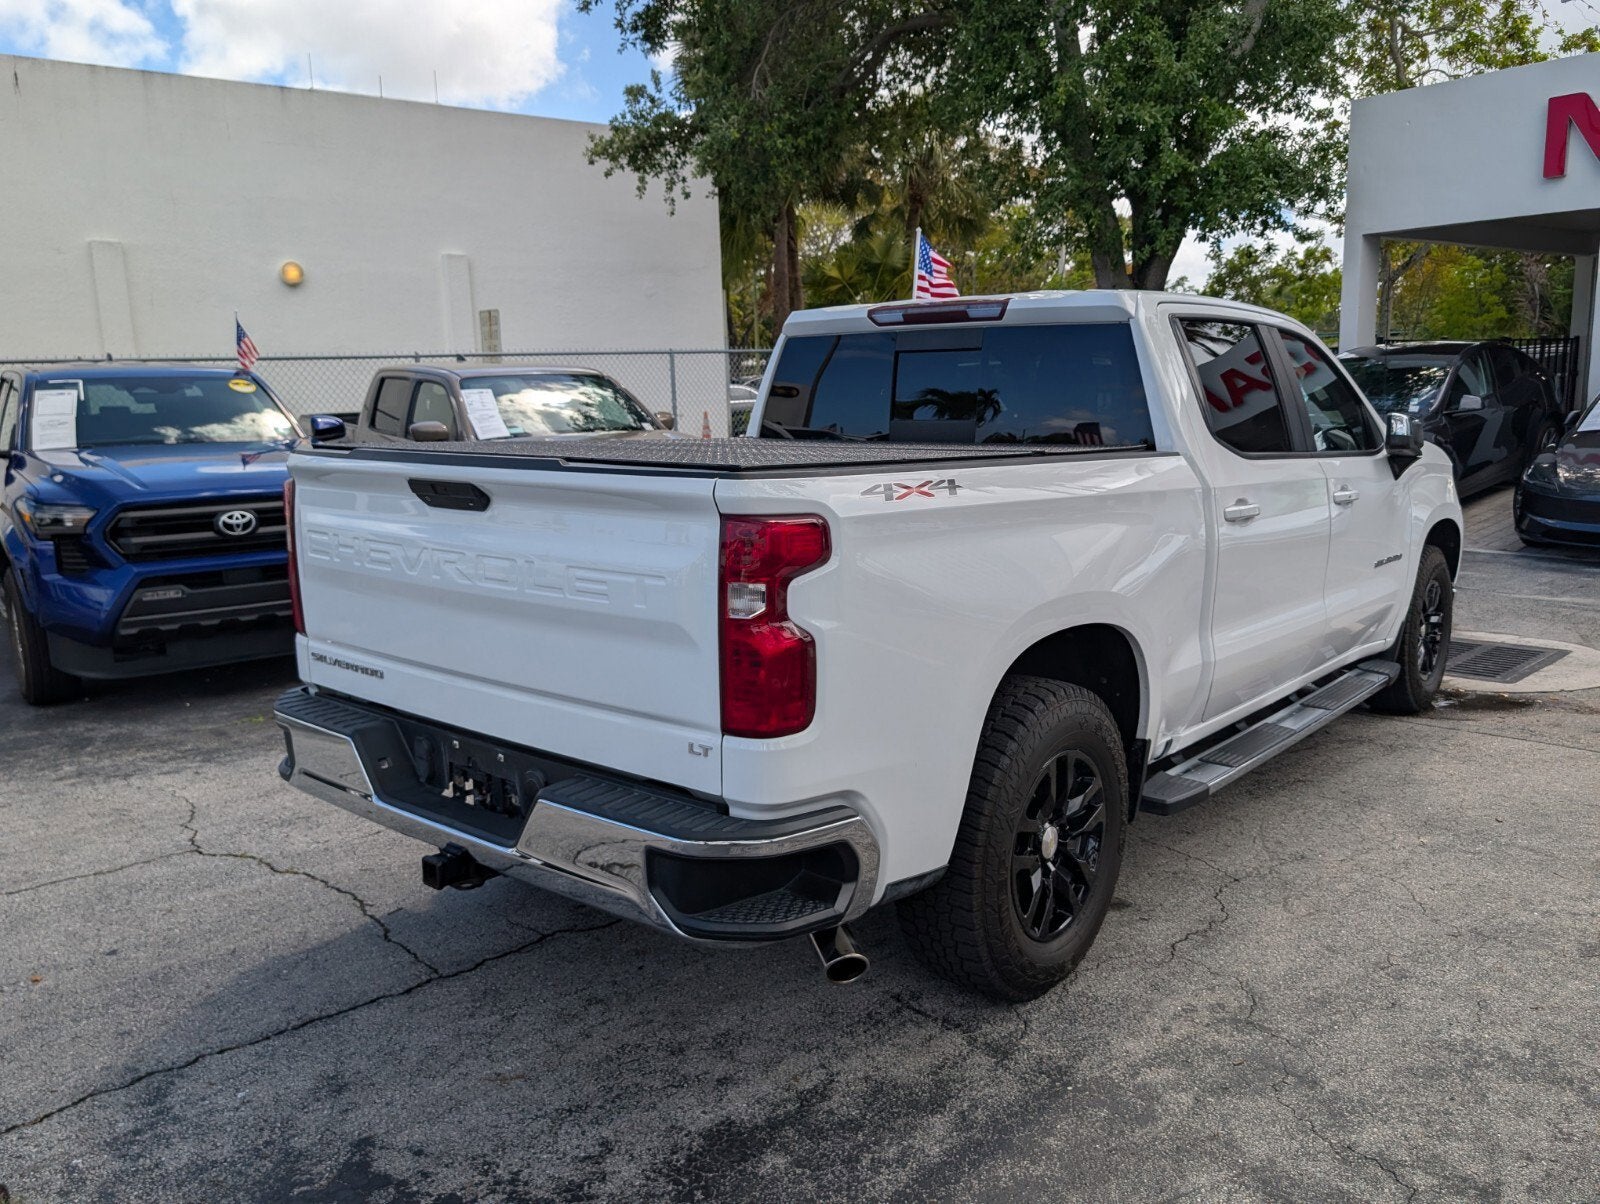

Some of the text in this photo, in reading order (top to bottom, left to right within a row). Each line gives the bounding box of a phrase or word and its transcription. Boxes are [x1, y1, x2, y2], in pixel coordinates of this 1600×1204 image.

[305, 529, 668, 609] CHEVROLET
[311, 651, 384, 680] SILVERADO
[687, 741, 713, 757] LT
